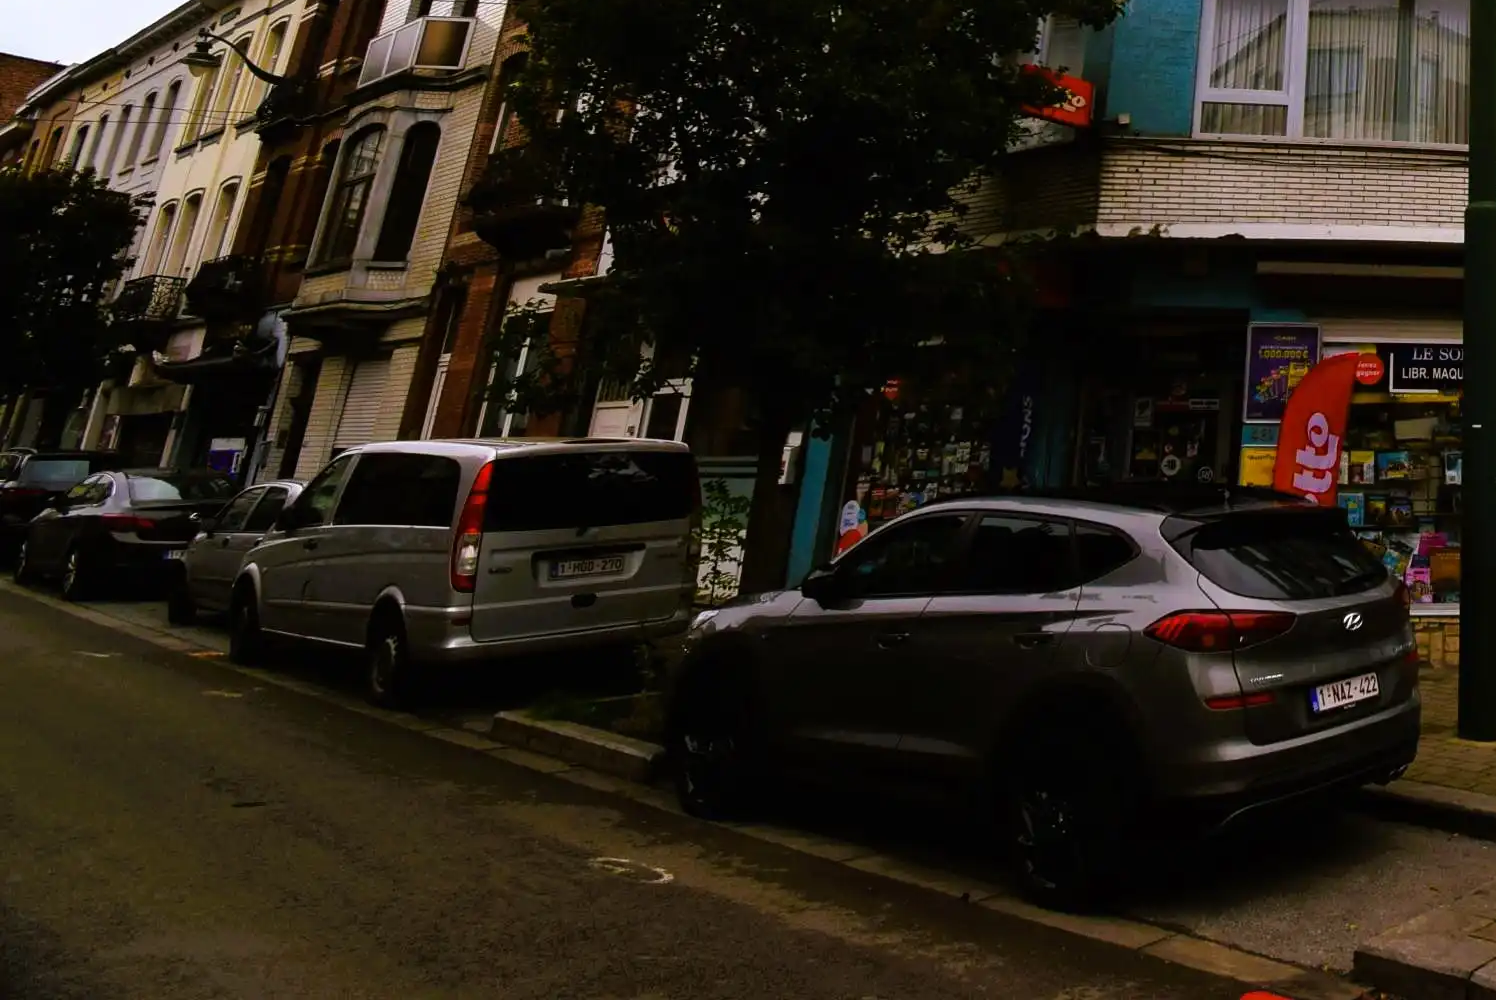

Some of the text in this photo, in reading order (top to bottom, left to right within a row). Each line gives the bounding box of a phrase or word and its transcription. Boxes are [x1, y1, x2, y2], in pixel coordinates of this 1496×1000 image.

[1411, 347, 1434, 361] LE
[1402, 367, 1464, 380] LIBR. MAQU
